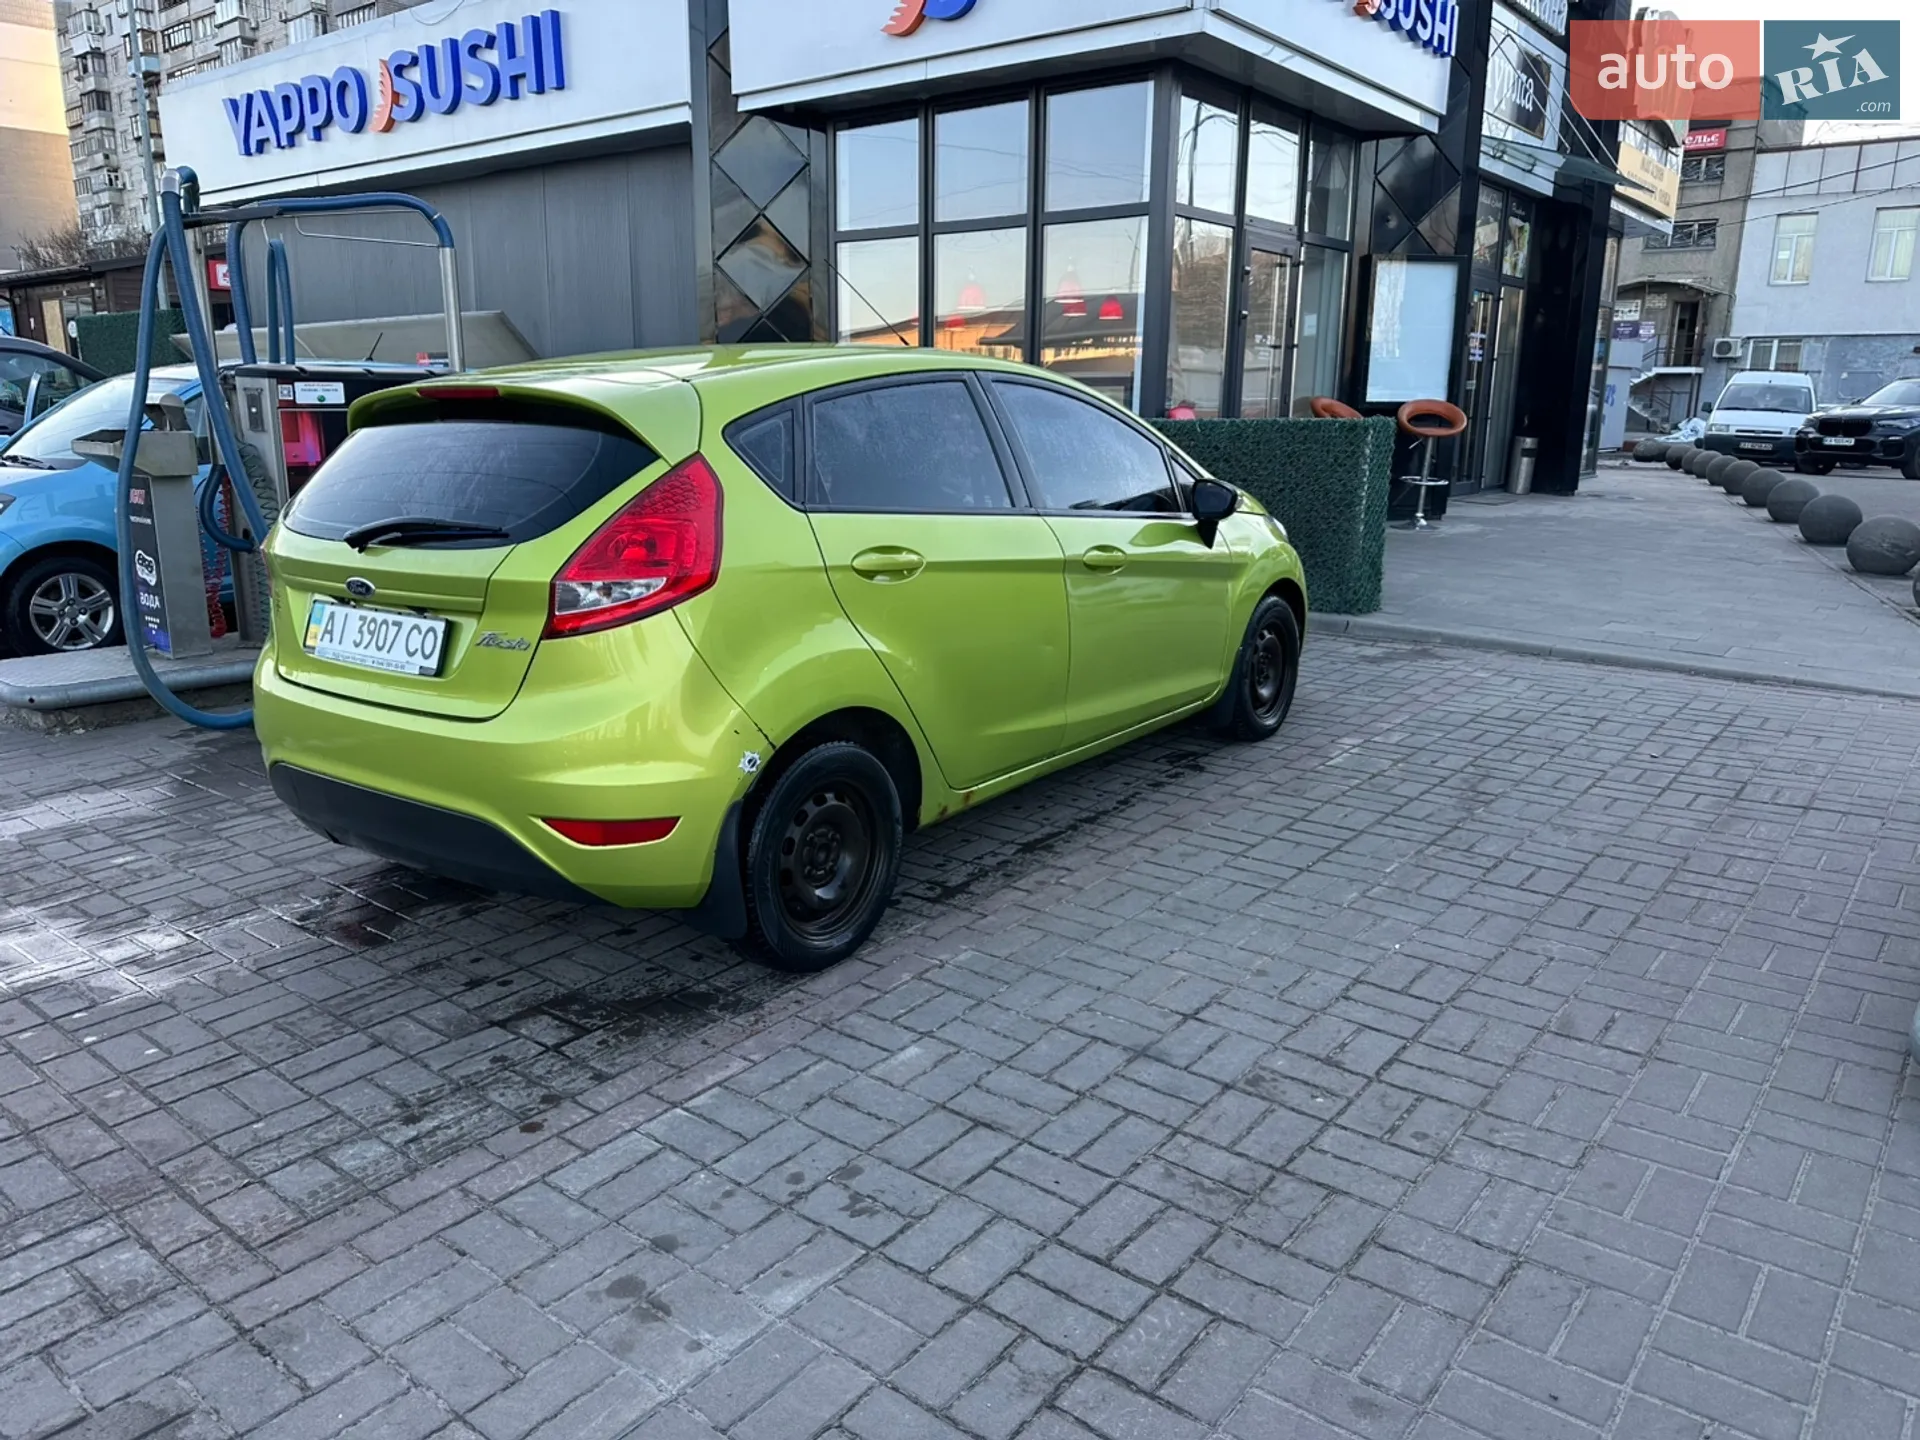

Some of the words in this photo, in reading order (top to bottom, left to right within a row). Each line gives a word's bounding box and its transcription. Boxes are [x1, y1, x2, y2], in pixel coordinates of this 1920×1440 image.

[222, 65, 368, 156] YAPPO
[387, 8, 565, 123] SUSHI
[320, 611, 348, 645] AI
[352, 615, 403, 654] 3907
[405, 623, 438, 660] CO
